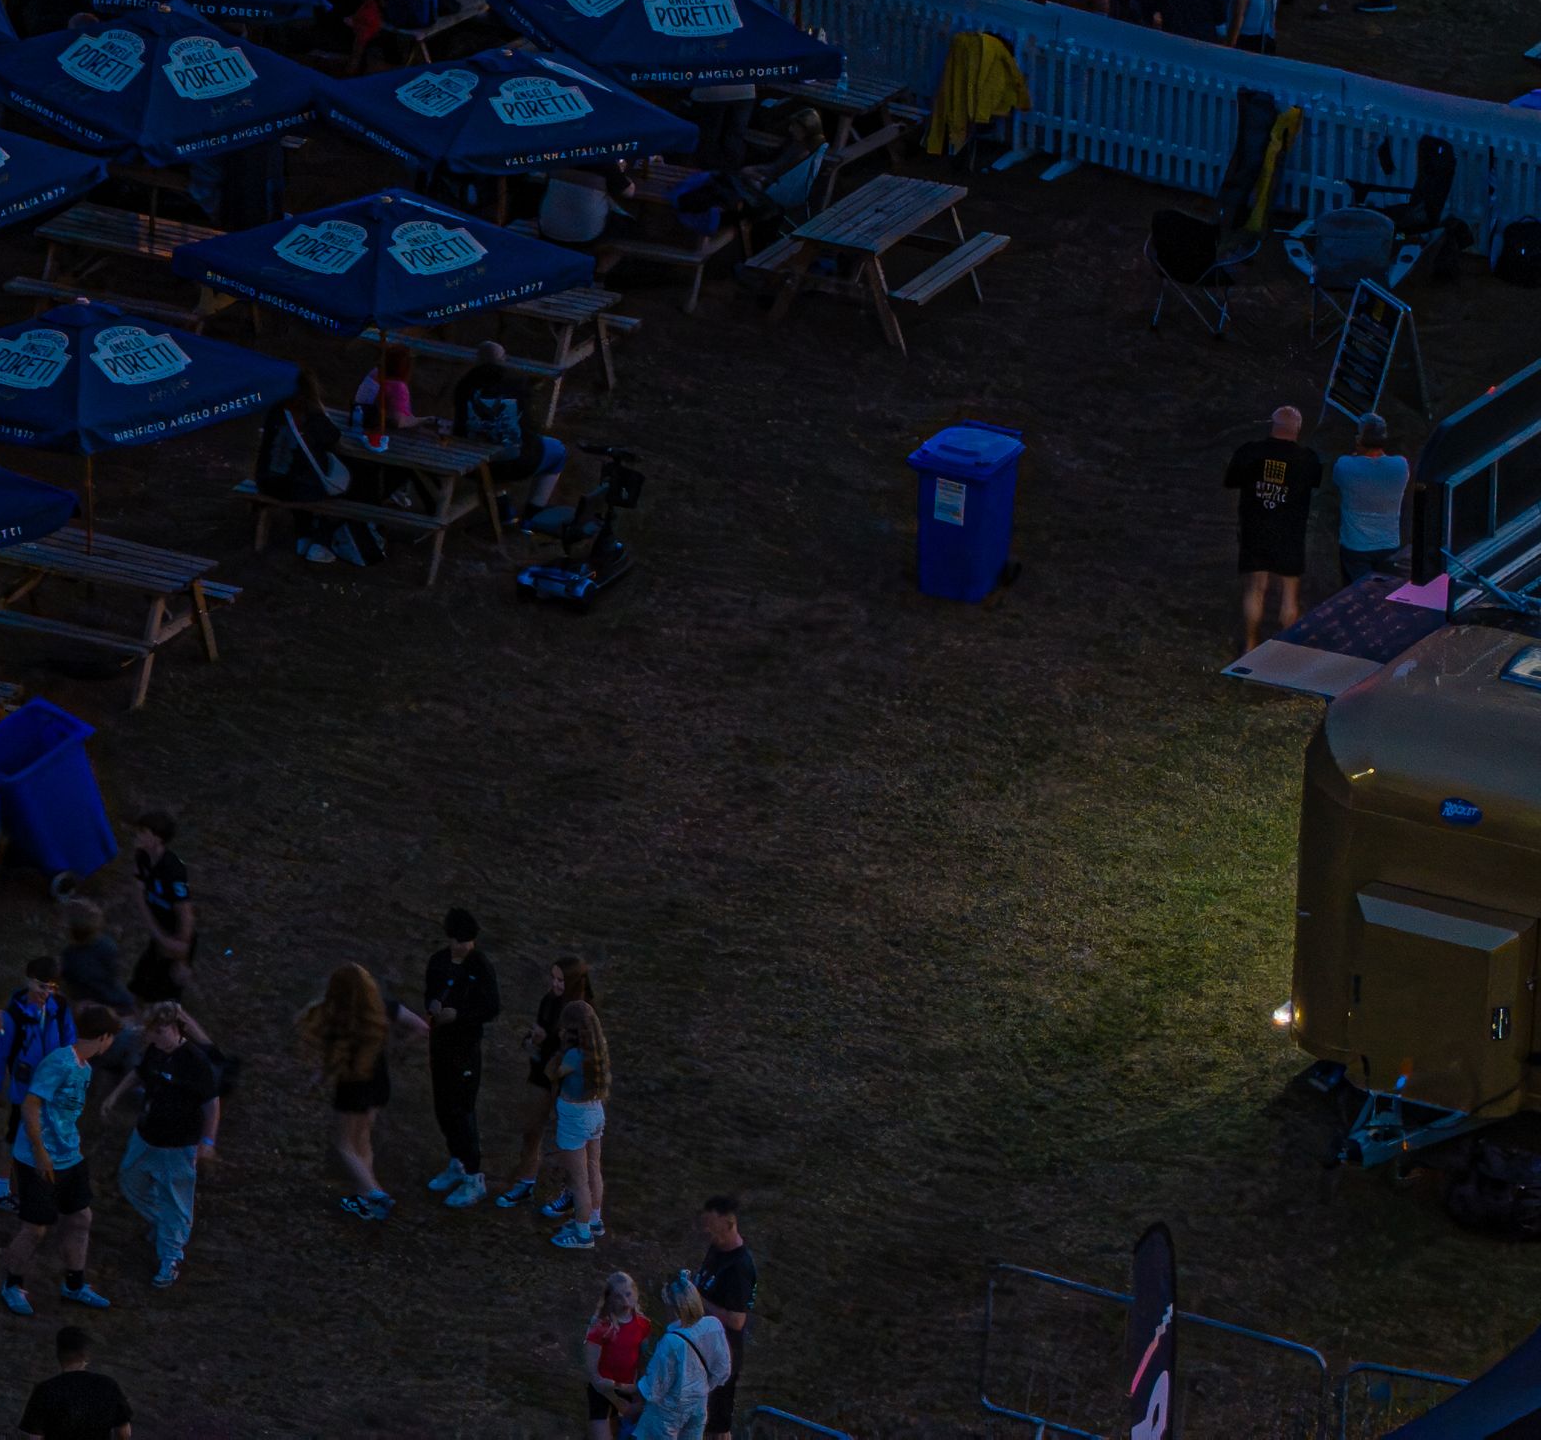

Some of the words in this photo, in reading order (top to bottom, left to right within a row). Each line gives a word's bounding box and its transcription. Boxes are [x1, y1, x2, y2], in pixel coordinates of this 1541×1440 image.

[656, 6, 731, 28] PORETTI
[174, 56, 247, 92] PORETTI
[502, 93, 582, 119] PORETTI
[401, 236, 473, 269] PORETTI
[105, 345, 176, 375] PORETTI
[114, 423, 167, 441] BIRRIFICIO
[170, 410, 210, 428] ANGELO
[214, 393, 261, 415] PORETTI
